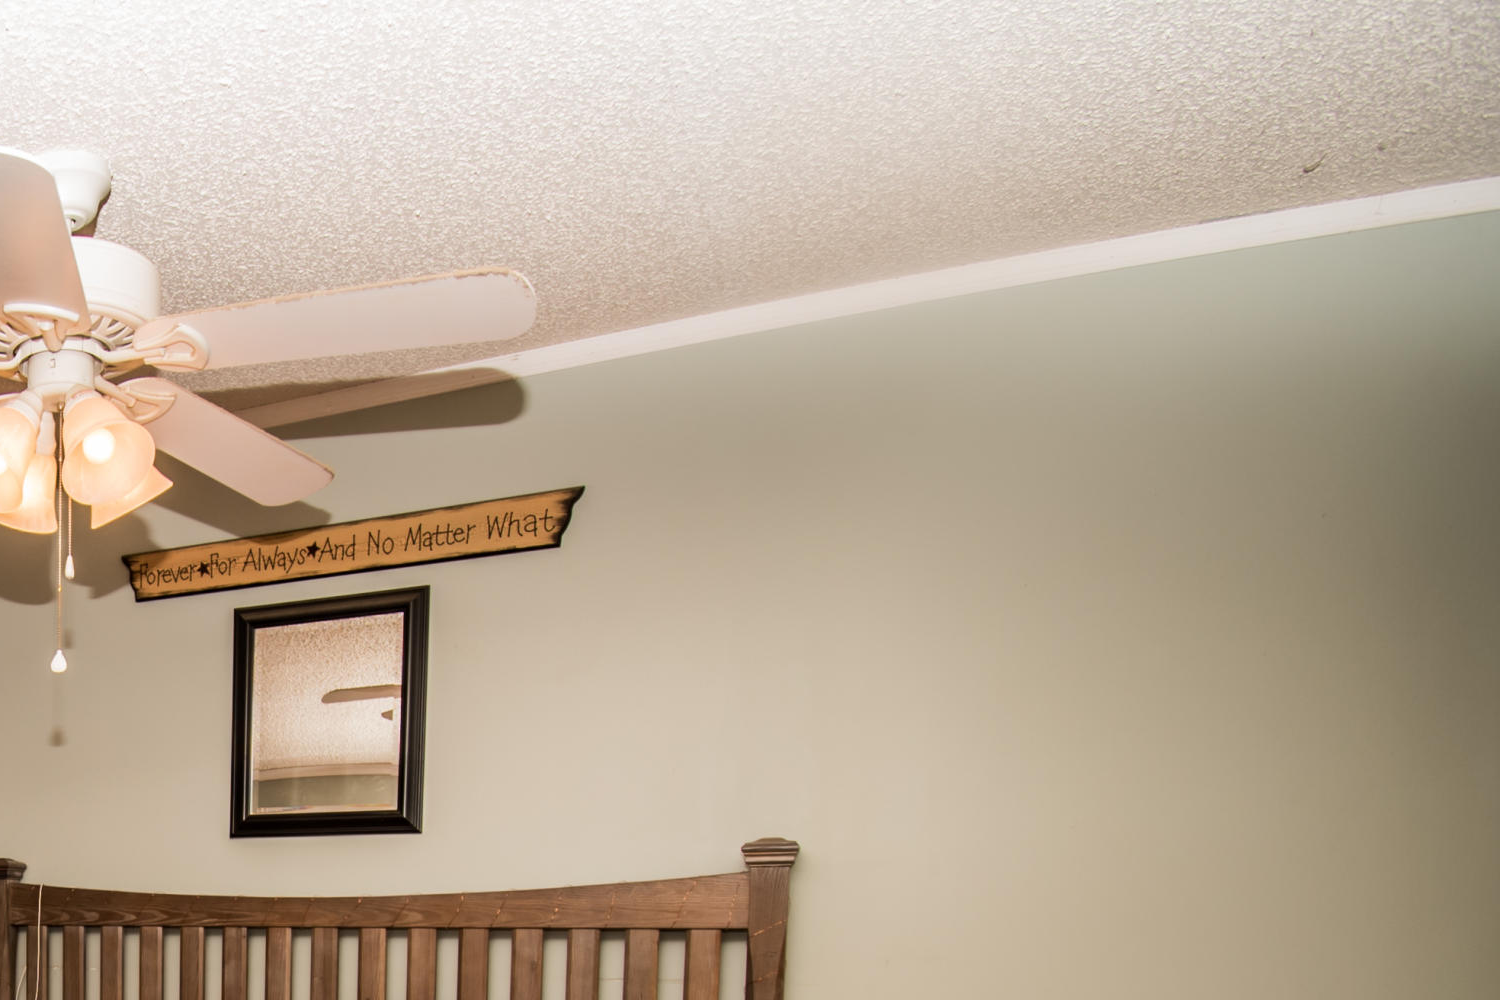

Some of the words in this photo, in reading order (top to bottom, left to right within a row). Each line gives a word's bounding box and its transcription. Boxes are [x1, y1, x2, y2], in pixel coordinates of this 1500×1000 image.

[139, 562, 198, 588] Forever
[209, 552, 238, 578] For
[242, 545, 307, 573] Always
[317, 534, 357, 562] And
[366, 530, 395, 556] No
[404, 523, 477, 551] Matter
[486, 508, 556, 539] What
